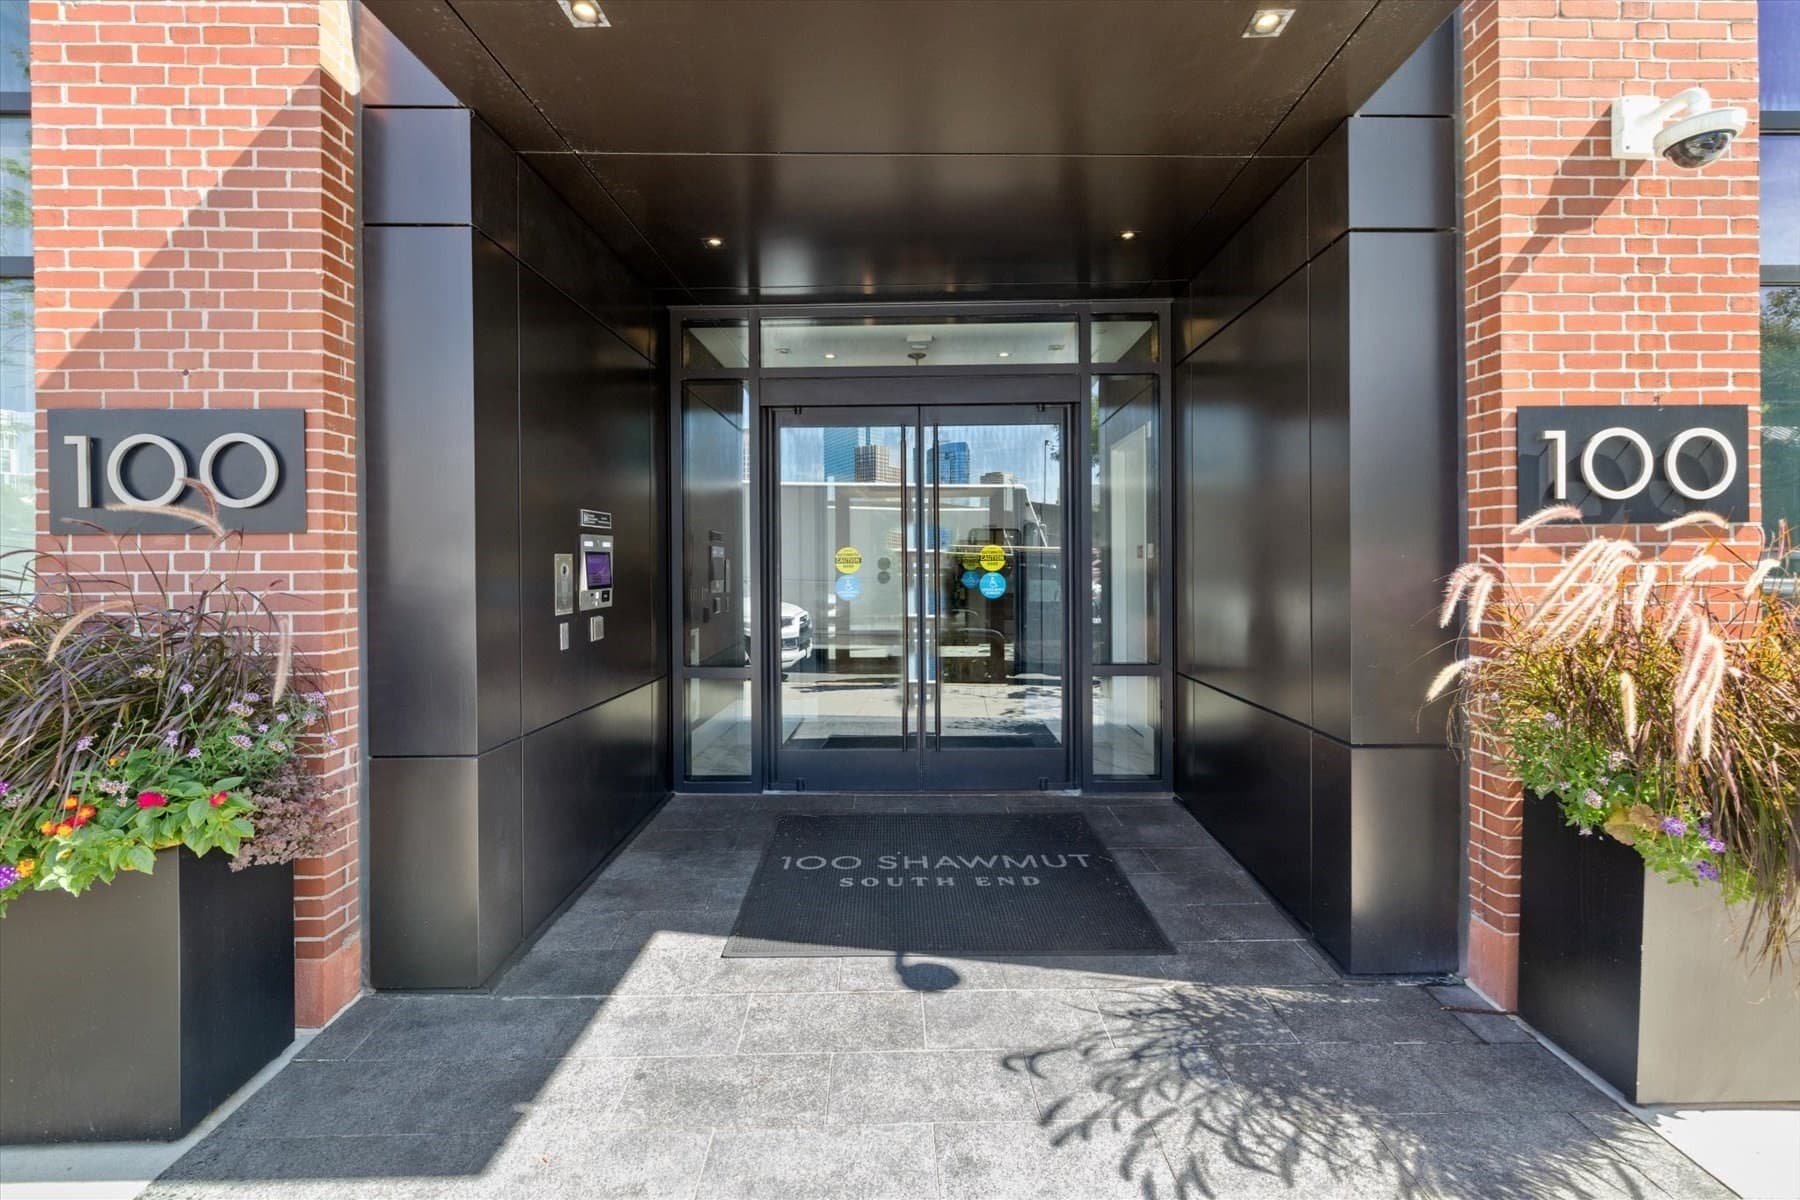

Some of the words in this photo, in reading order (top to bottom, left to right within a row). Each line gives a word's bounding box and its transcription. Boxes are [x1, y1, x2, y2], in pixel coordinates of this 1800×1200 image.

[62, 432, 280, 509] 100
[1543, 427, 1737, 500] 100
[780, 855, 862, 870] 100
[877, 854, 1090, 869] SHAWMUT
[838, 876, 955, 888] SOUTH
[974, 876, 1041, 887] END
